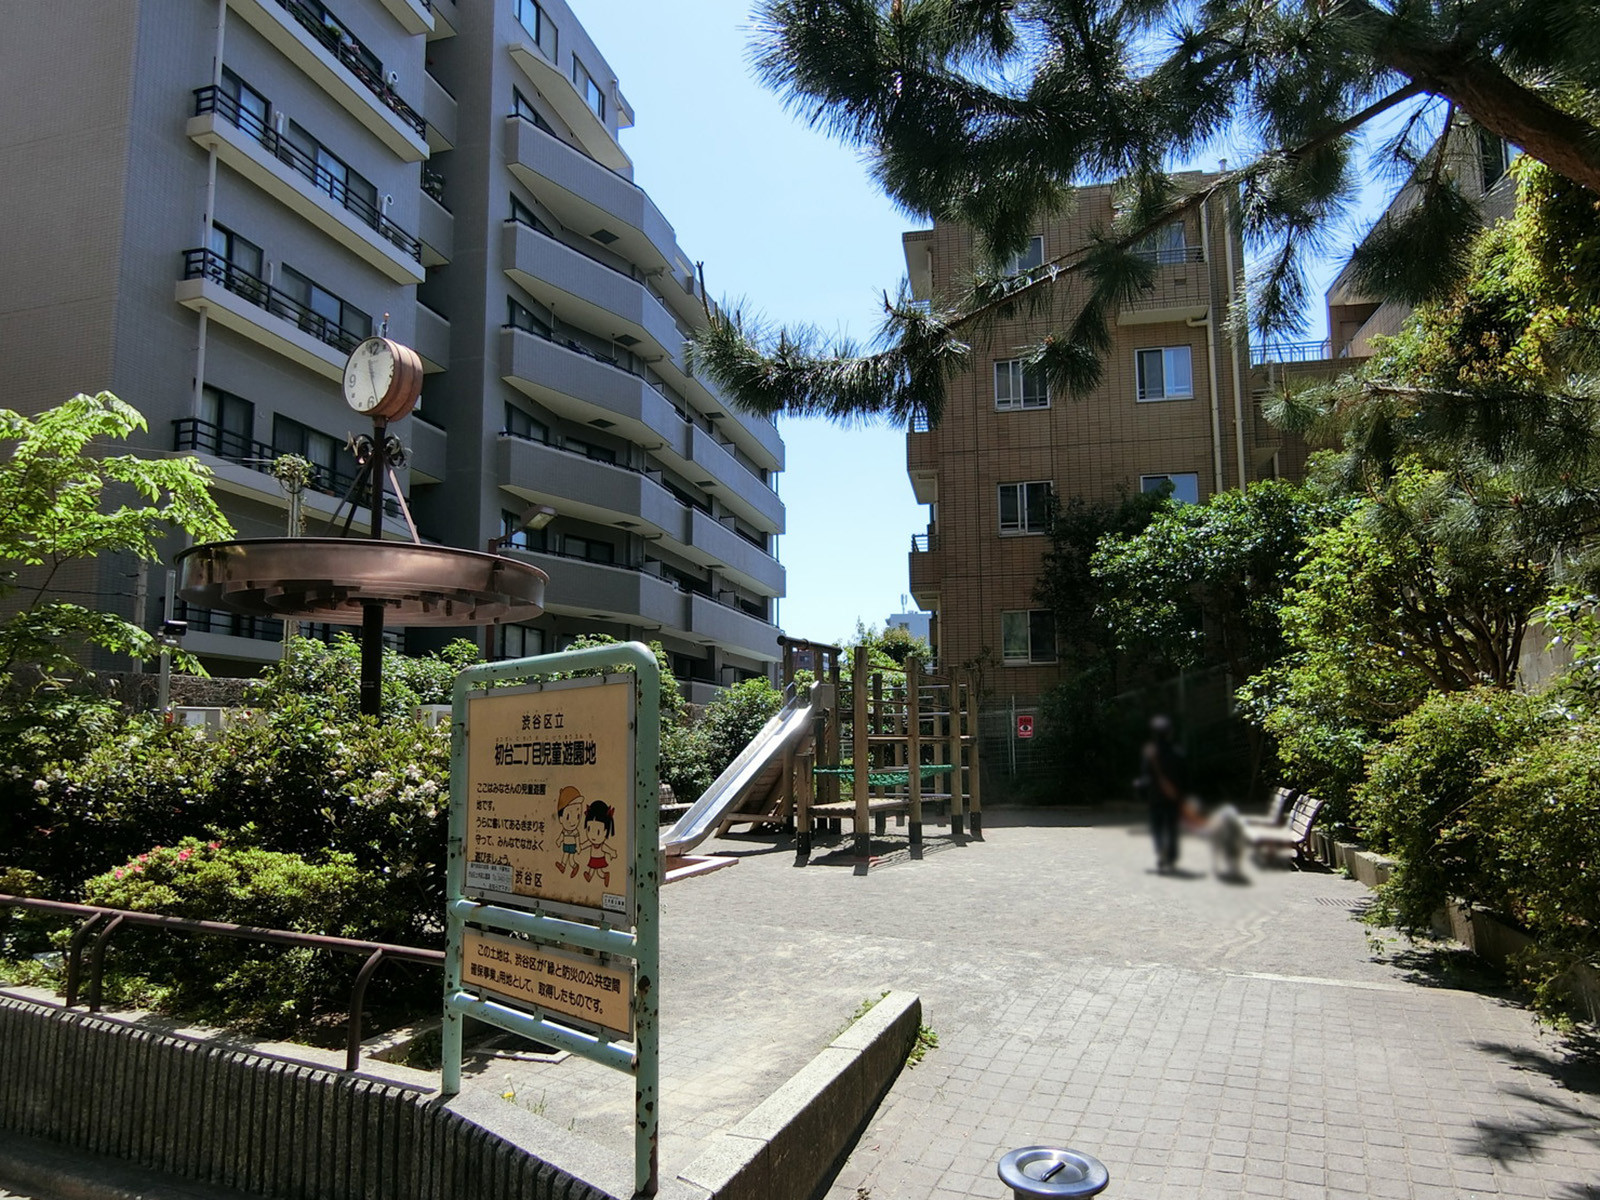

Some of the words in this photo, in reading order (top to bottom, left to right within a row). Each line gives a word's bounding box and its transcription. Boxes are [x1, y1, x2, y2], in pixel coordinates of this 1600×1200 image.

[349, 374, 357, 388] 9
[367, 396, 375, 409] 6
[522, 712, 564, 730] 渋谷区立
[494, 740, 597, 766] 初台二丁目児童遊園地
[476, 782, 547, 796] ここはみなさんの児童遊園
[475, 817, 545, 833] うらに書いてあるきまりを
[515, 870, 543, 888] 渋谷区
